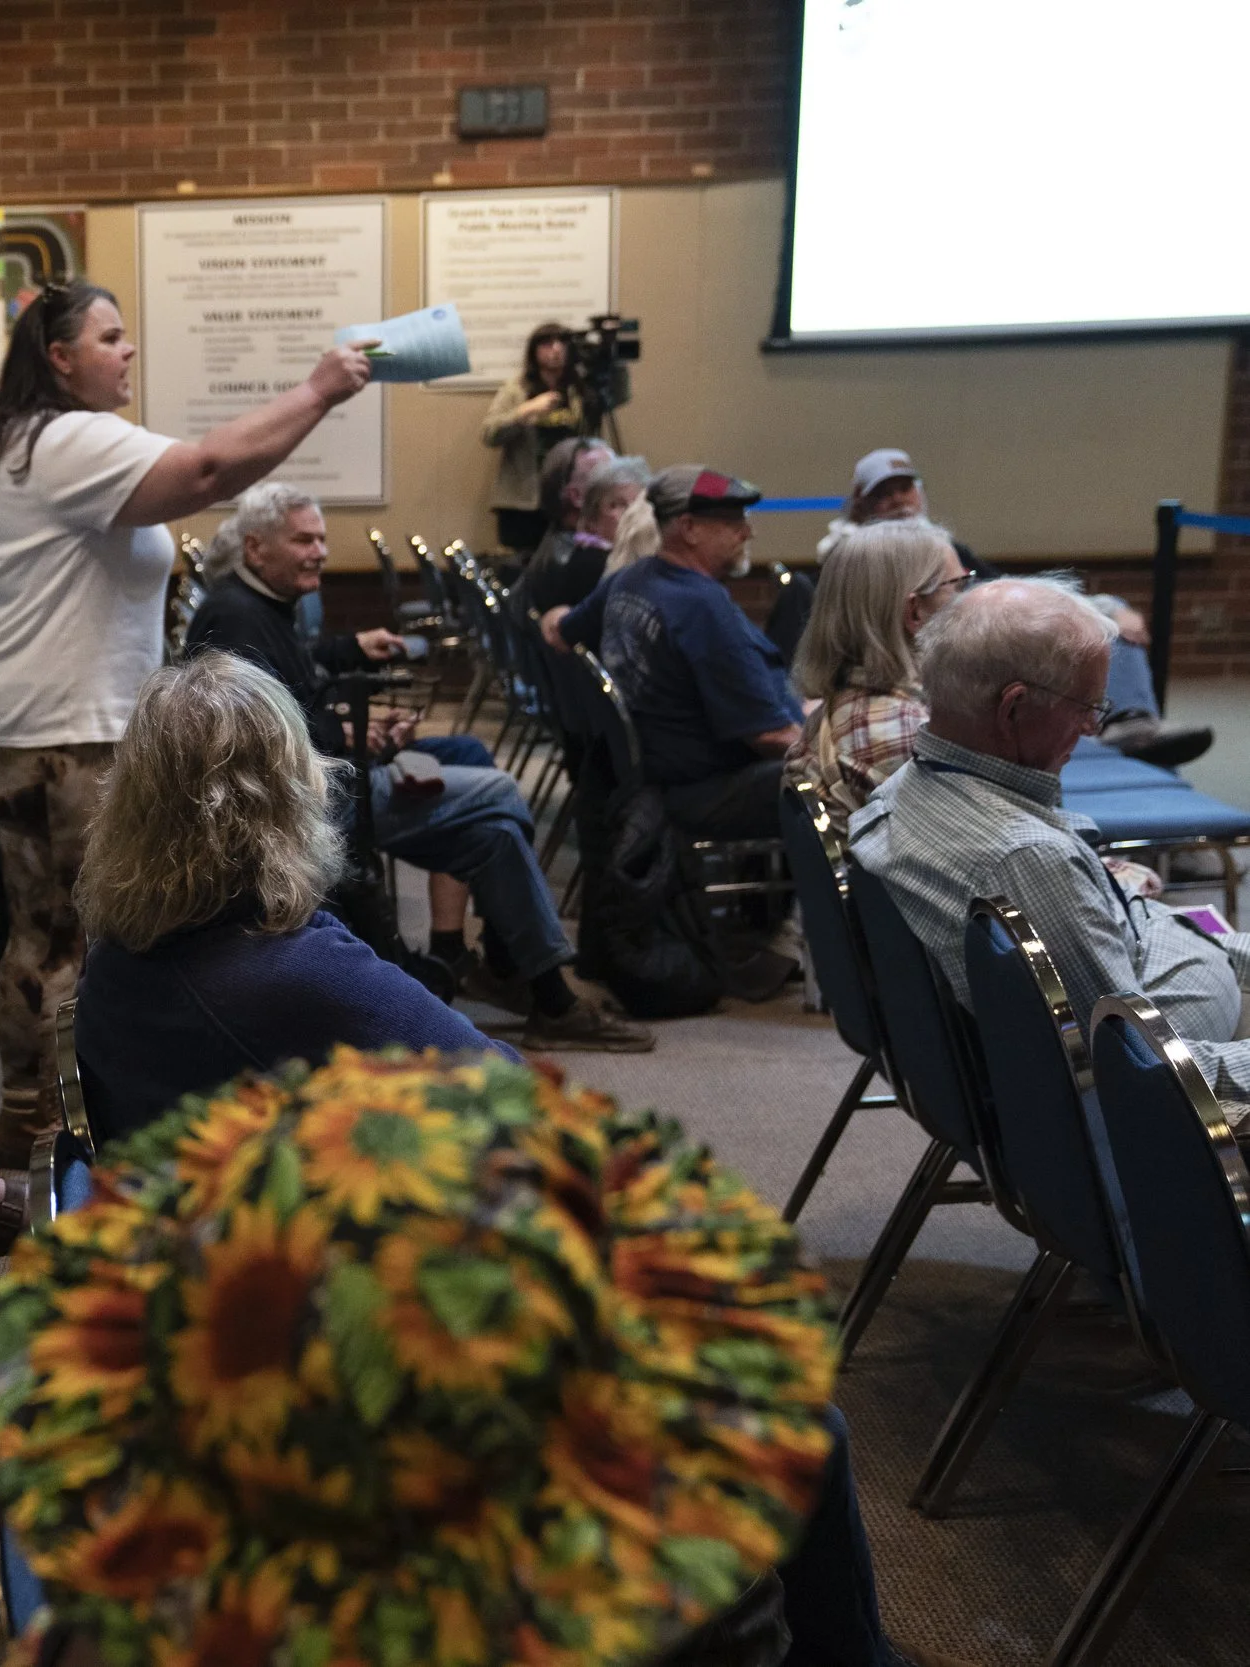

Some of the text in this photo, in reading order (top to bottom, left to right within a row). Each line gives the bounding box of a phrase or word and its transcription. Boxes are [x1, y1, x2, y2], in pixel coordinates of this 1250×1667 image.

[199, 256, 326, 270] VISION STATEMENT
[248, 309, 323, 321] STATEMENT
[208, 382, 269, 394] COUNCIL
